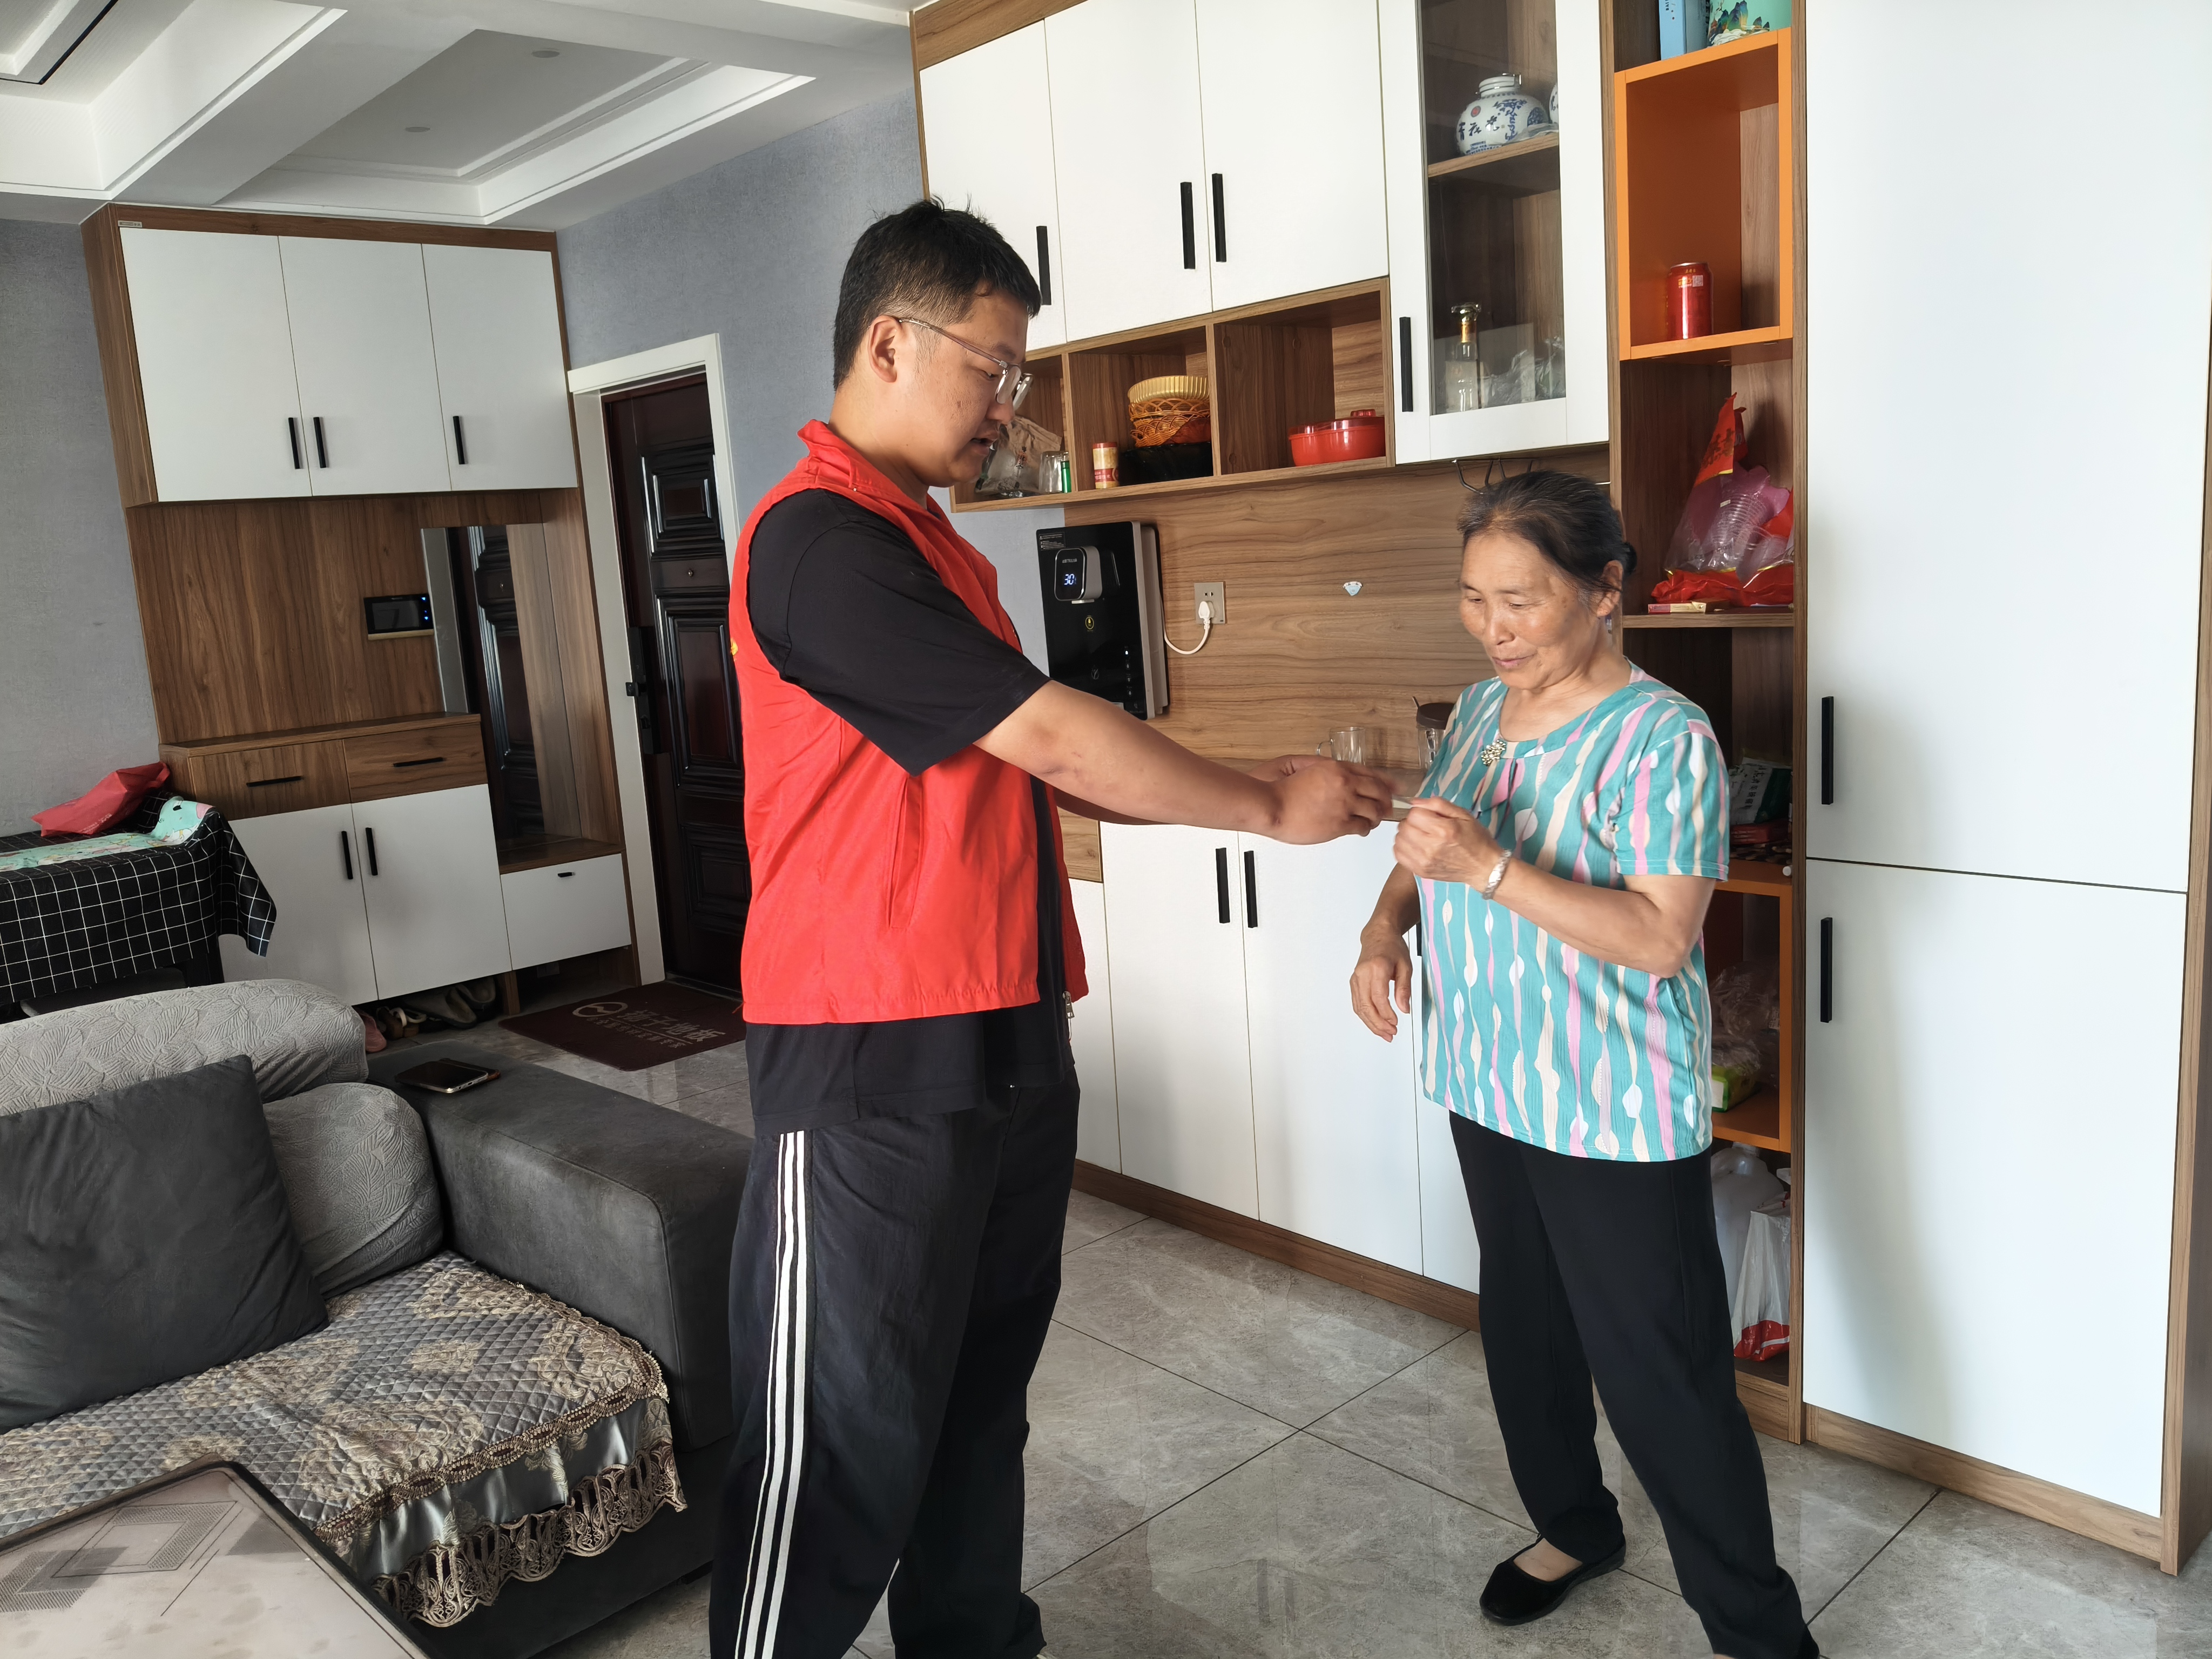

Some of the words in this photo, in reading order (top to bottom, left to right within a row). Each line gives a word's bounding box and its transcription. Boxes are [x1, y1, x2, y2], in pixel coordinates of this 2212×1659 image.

[1064, 574, 1075, 585] 30
[617, 1010, 726, 1042] 扬子地板
